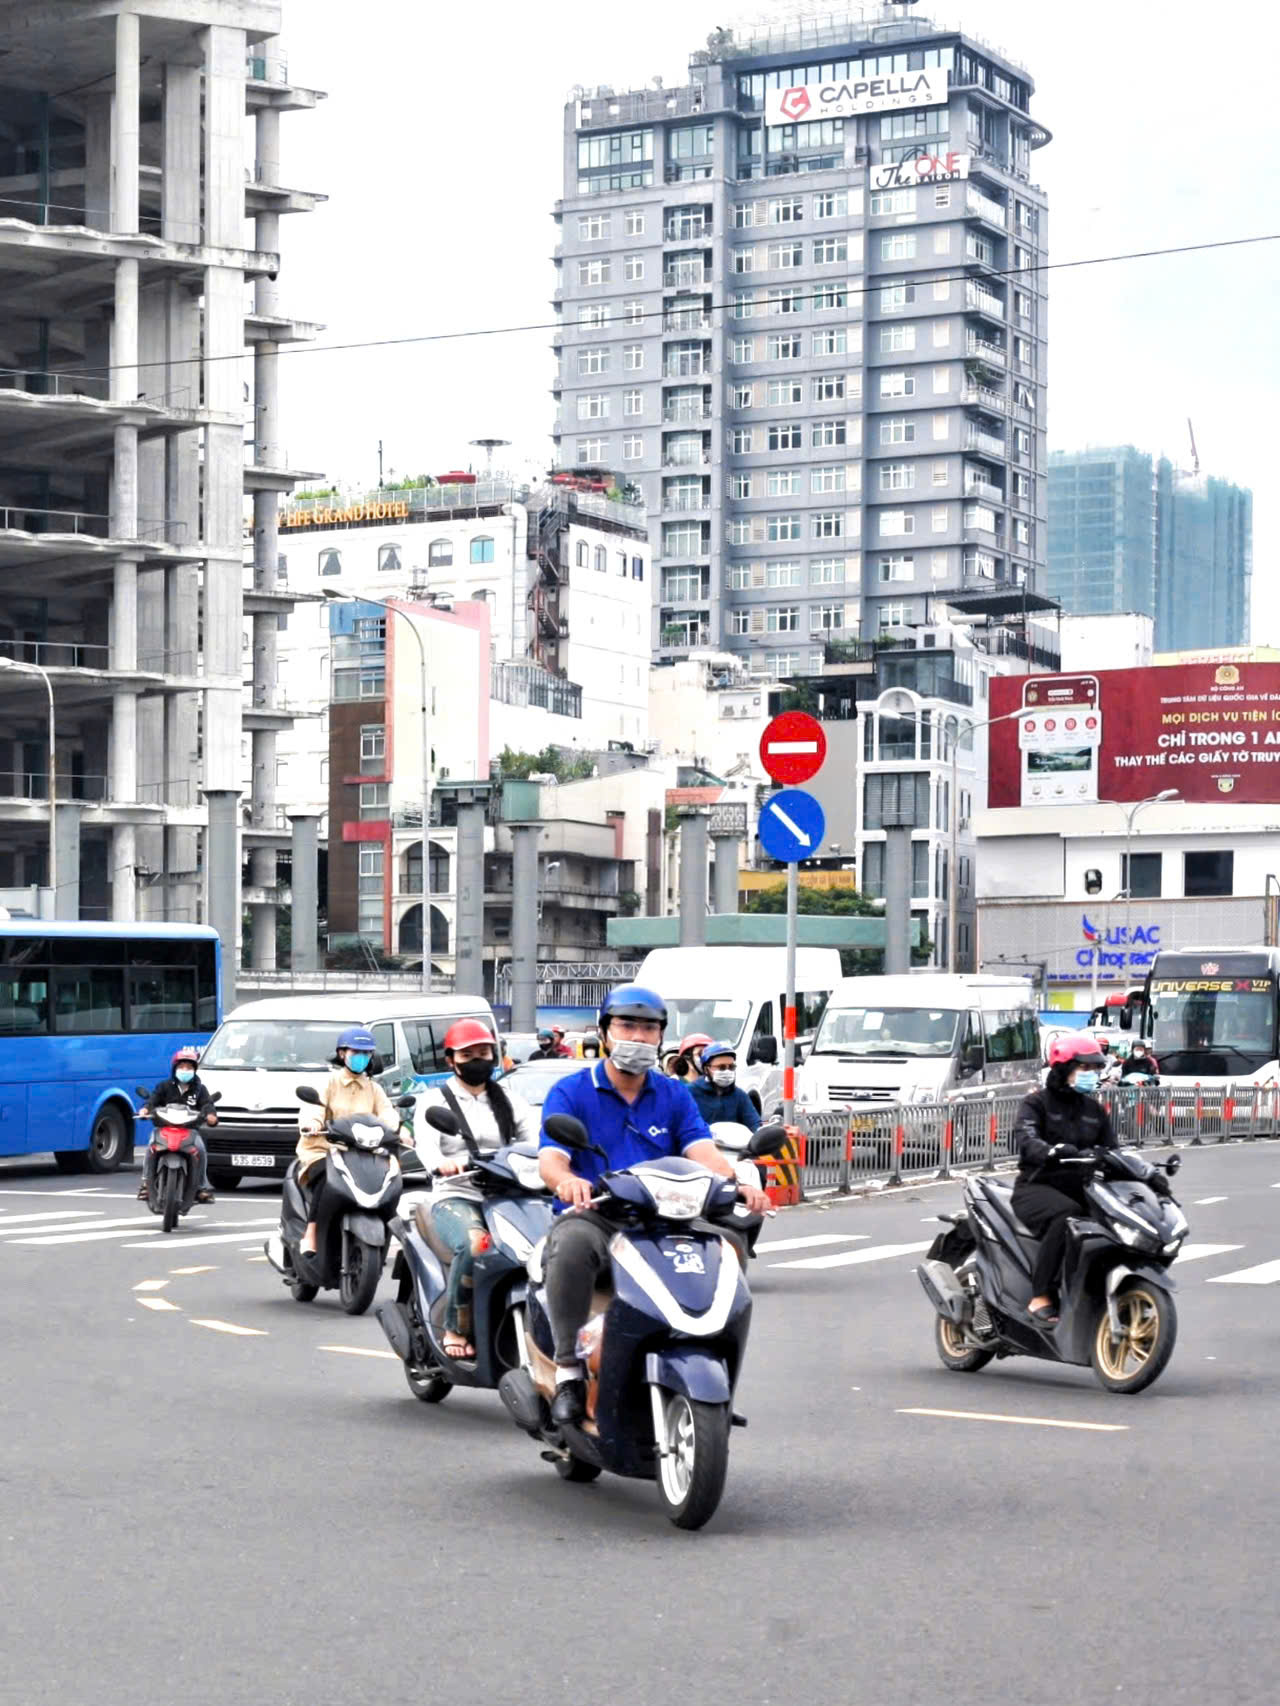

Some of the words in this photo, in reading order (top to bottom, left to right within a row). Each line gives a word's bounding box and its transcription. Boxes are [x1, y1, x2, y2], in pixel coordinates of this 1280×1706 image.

[820, 74, 930, 103] CAPELLA
[821, 93, 933, 114] HOLDINGS
[876, 156, 914, 188] The
[915, 152, 960, 177] ONE
[287, 509, 311, 527] LIFE
[313, 503, 363, 524] GRAND
[365, 500, 408, 520] HOTEL
[1162, 713, 1185, 724] MỌI
[1189, 711, 1219, 723] DỊCH
[1223, 711, 1239, 722] VỤ
[1242, 709, 1267, 722] TIỆN
[1158, 730, 1186, 747] CHỈ
[1189, 731, 1246, 746] TRONG
[1251, 731, 1259, 745] 1
[1114, 755, 1143, 767] THAY
[1145, 751, 1166, 765] THẾ
[1169, 751, 1195, 764] CÁC
[1198, 750, 1228, 763] GIẤY
[1232, 750, 1249, 762] TỜ
[1150, 981, 1234, 992] UNIVERSE
